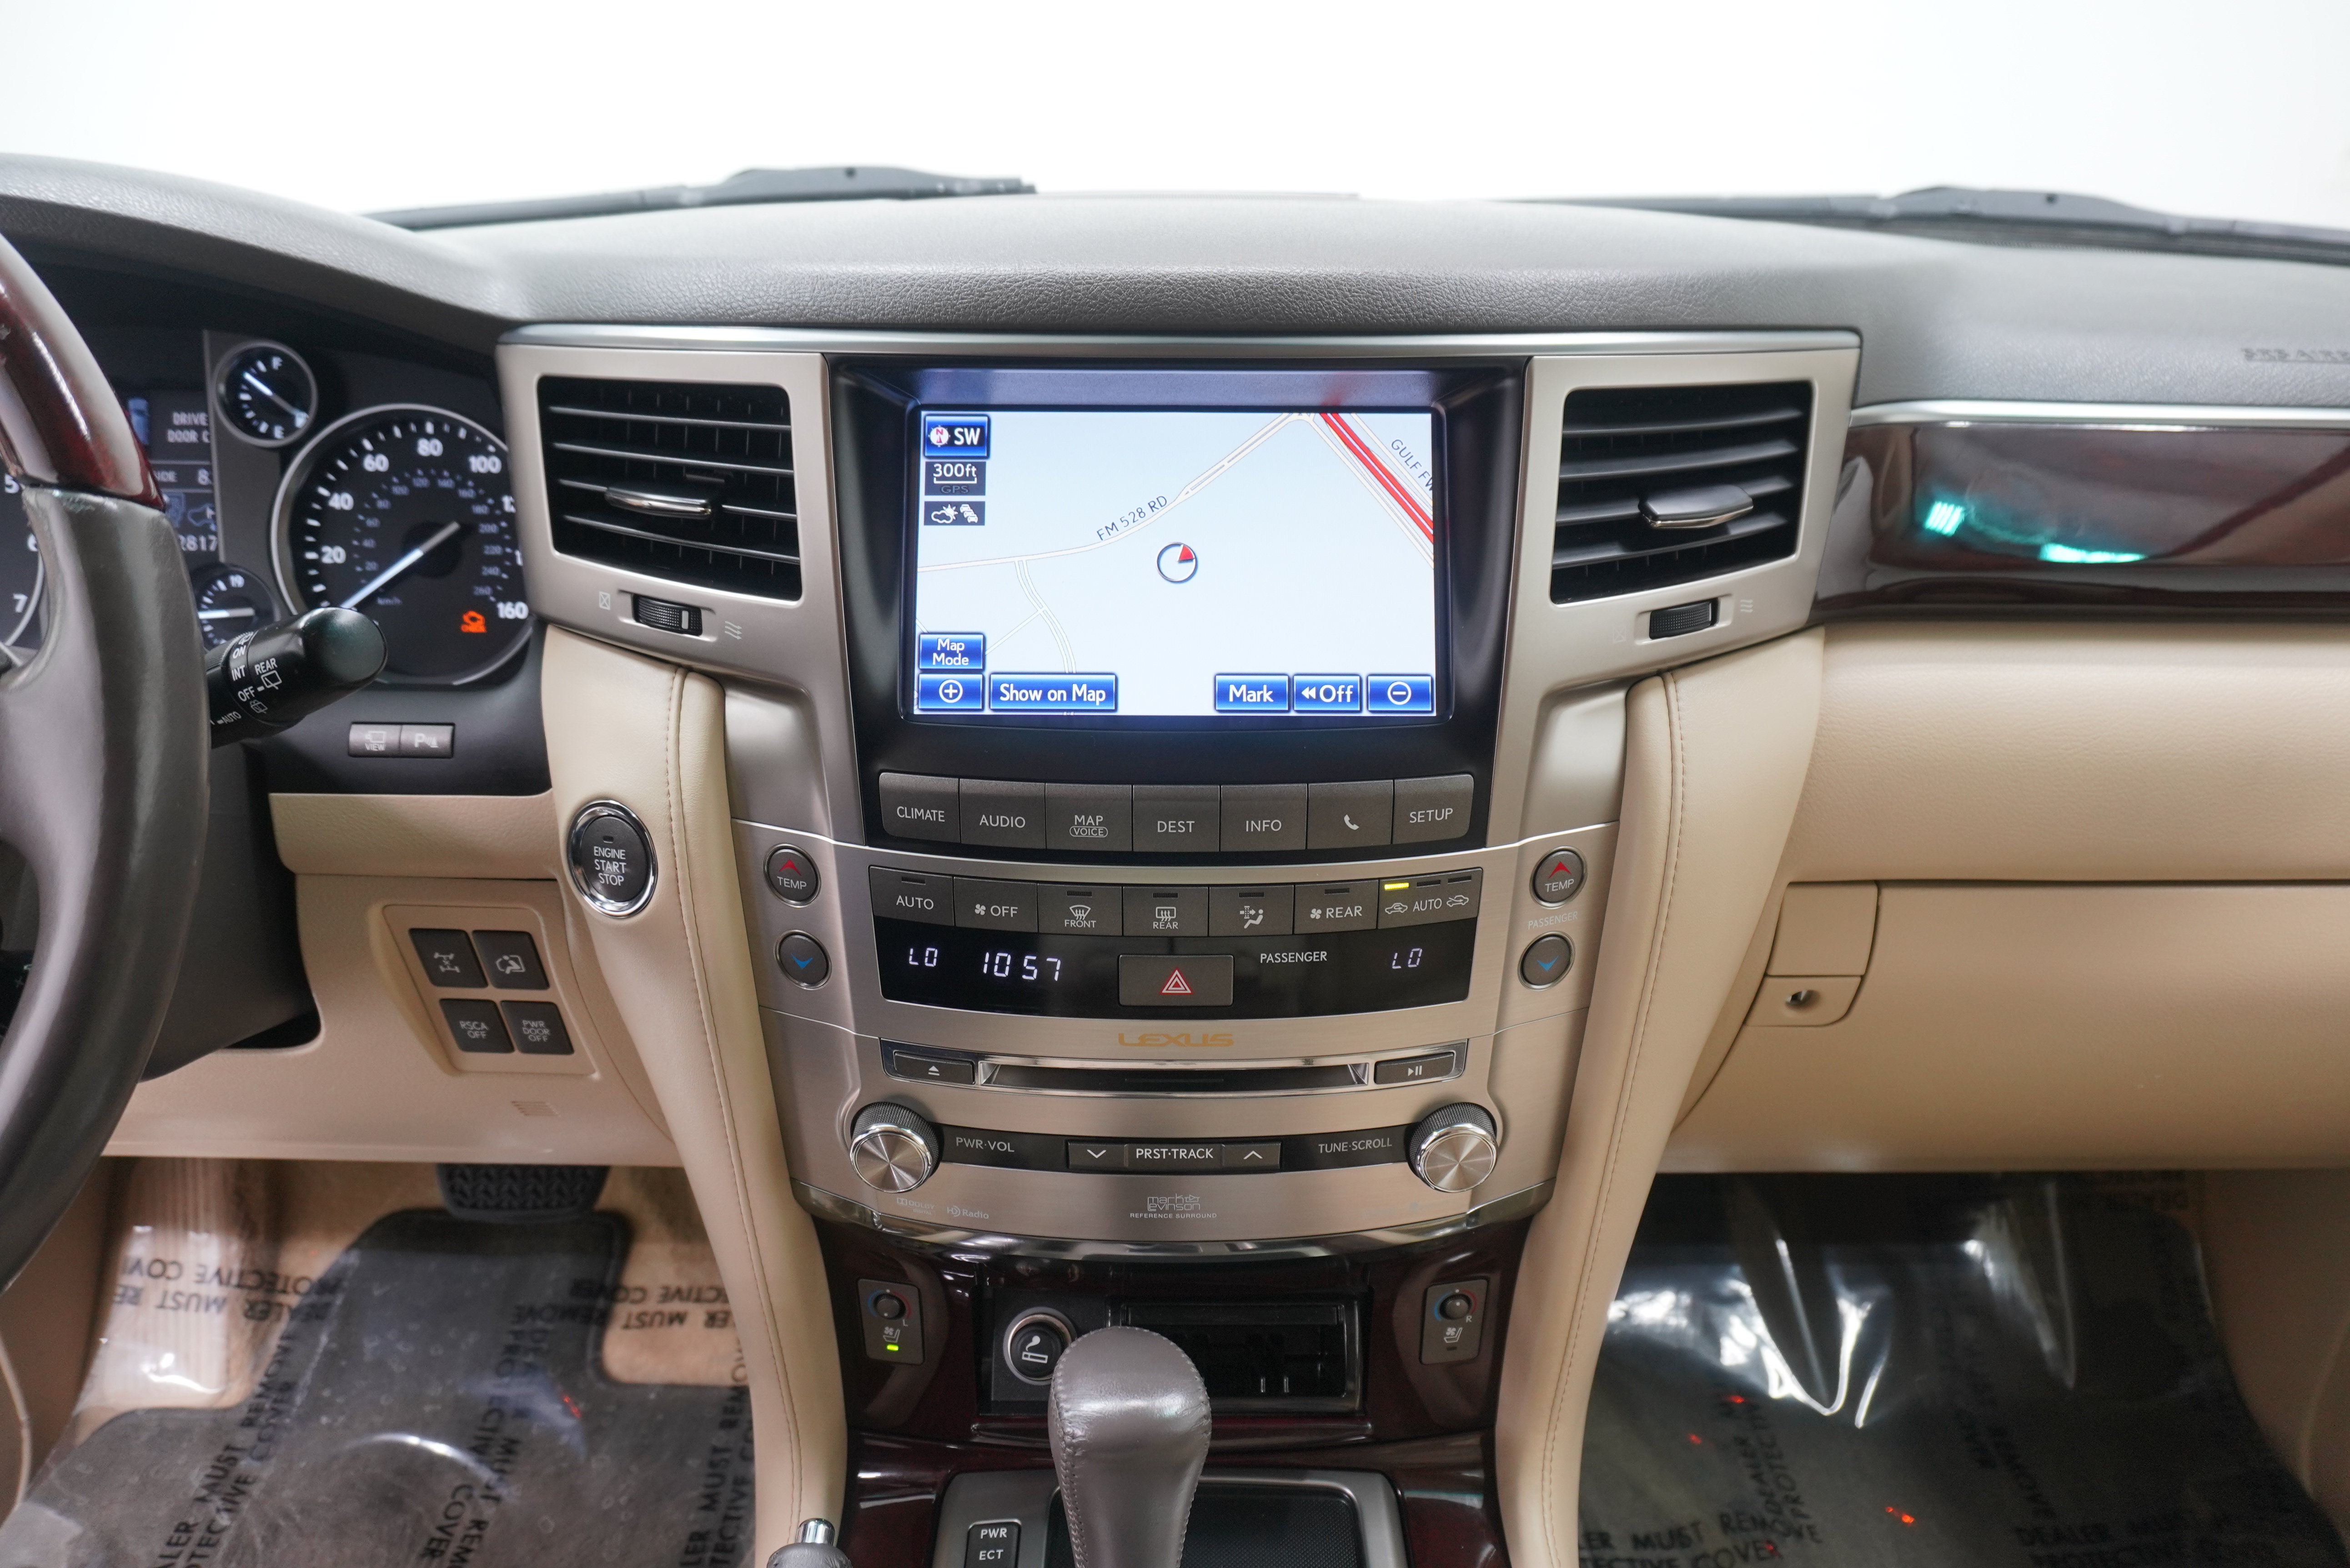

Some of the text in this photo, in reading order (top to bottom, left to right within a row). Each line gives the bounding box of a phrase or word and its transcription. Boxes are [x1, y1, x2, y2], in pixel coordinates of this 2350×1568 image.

[271, 356, 283, 370] F
[167, 430, 198, 443] DOOR
[274, 425, 285, 439] E
[954, 427, 980, 445] SW
[417, 438, 443, 457] 80
[1391, 439, 1422, 469] GULF
[363, 454, 389, 472] 60
[468, 456, 501, 474] 100
[933, 463, 977, 477] 300ft
[5, 474, 19, 494] 5
[941, 485, 969, 494] GPS
[328, 493, 354, 511] 40
[1096, 495, 1169, 541] FM 528 RD
[321, 546, 346, 564] 20
[13, 593, 28, 613] 7
[497, 602, 528, 619] 160
[233, 645, 246, 659] ON
[937, 639, 964, 653] Map
[255, 658, 277, 675] REAR
[932, 653, 969, 666] Mode
[231, 665, 246, 681] INT
[238, 686, 256, 703] OFF
[999, 684, 1106, 705] Show on Map
[1228, 684, 1274, 702] Mark
[1319, 684, 1353, 702] Off
[222, 711, 242, 724] AUTO
[896, 806, 945, 822] CLIMATE
[1074, 815, 1103, 826] MAP
[1409, 808, 1453, 824] SETUP
[979, 815, 1025, 828] AUDIO
[1157, 821, 1195, 833] DEST
[1245, 820, 1282, 832] INFO
[1074, 828, 1104, 836] VOICE
[593, 846, 626, 860] ENGINE
[594, 860, 626, 874] START
[598, 873, 625, 886] STOP
[777, 876, 807, 890] TEMP
[1545, 878, 1574, 893] TEMP
[896, 896, 934, 910] AUTO
[1413, 899, 1442, 912] AUTO
[990, 906, 1018, 918] OFF
[1326, 906, 1362, 919] REAR
[1065, 920, 1096, 929] FRONT
[1153, 921, 1178, 930] REAR
[1528, 911, 1578, 930] PASSENGER
[1260, 951, 1327, 964] PASSENGER
[460, 1020, 488, 1031] RSCA
[522, 1020, 545, 1028] PWR
[467, 1030, 487, 1040] OFF
[522, 1027, 550, 1036] DOOR
[528, 1035, 548, 1043] OFF
[1118, 1033, 1234, 1047] LEXUS
[909, 1201, 935, 1210] DOLBY
[962, 1208, 990, 1220] Radio
[193, 1264, 336, 1296] OTECTIVE
[155, 1291, 227, 1315] MUST
[621, 1310, 688, 1330] MUST
[902, 1319, 909, 1327] L
[1465, 1314, 1473, 1323] R
[193, 1442, 251, 1503] MUST
[697, 1444, 734, 1512] MUST
[416, 1483, 474, 1564] COVER
[1630, 1520, 1705, 1550] MUST
[1717, 1511, 1823, 1545] REMOVE
[980, 1528, 1007, 1540] PWR
[448, 1518, 490, 1568] REM
[979, 1549, 1004, 1561] ECT
